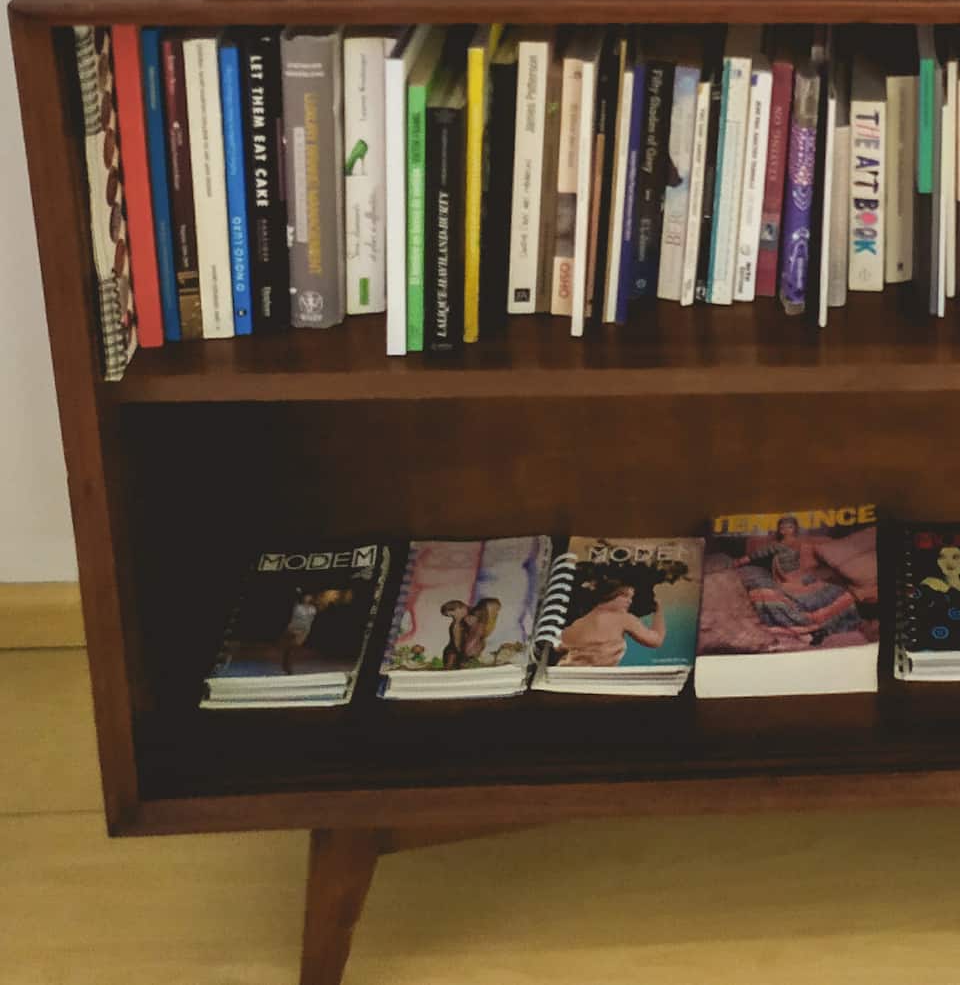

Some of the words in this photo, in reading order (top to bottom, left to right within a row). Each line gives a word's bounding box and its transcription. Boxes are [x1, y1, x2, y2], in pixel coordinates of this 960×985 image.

[250, 55, 263, 79] LET
[252, 87, 265, 127] THEM
[253, 135, 267, 162] EAT
[854, 109, 880, 150] THE
[255, 167, 269, 207] CAKE
[853, 198, 879, 255] BOOK
[258, 545, 377, 571] MODEM
